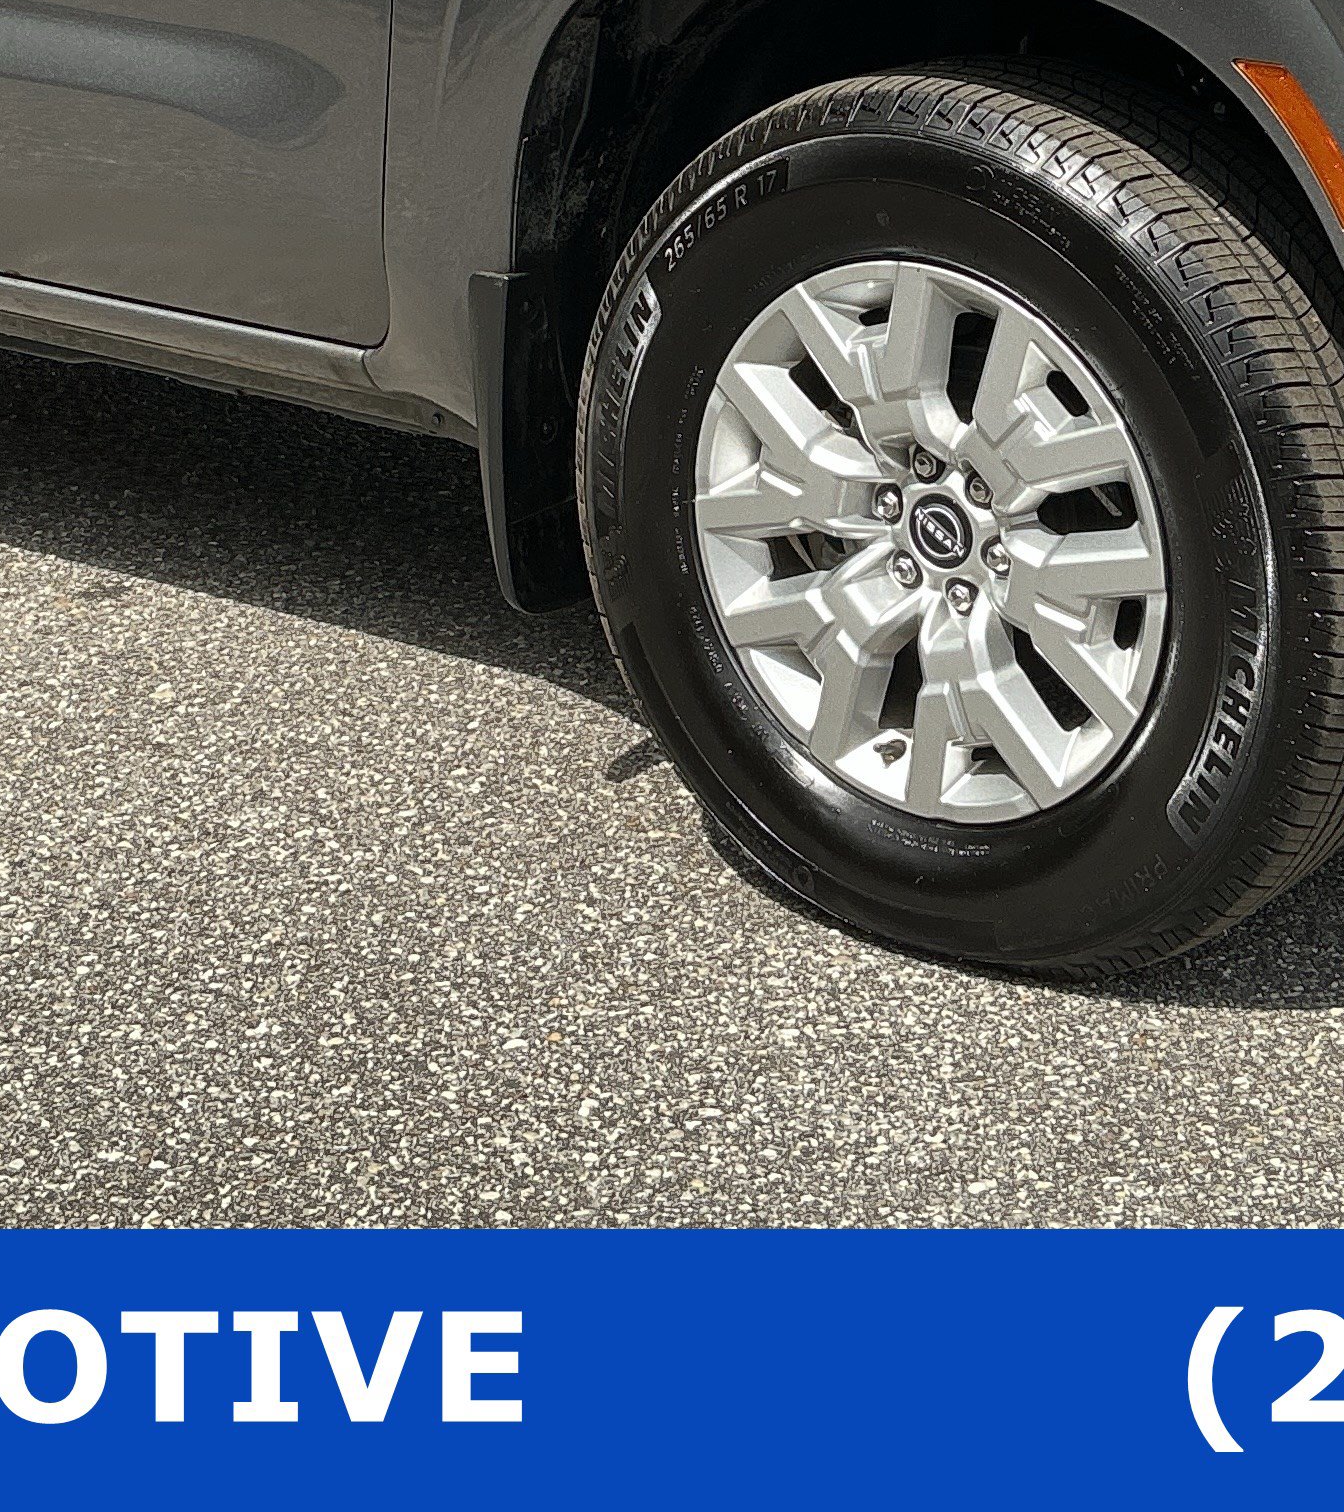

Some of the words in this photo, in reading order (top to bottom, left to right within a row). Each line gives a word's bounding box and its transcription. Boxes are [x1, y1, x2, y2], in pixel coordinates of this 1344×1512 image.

[664, 196, 728, 272] 265/65
[735, 186, 748, 207] R
[757, 169, 776, 195] 17
[915, 507, 965, 558] NISSAN
[1177, 576, 1258, 836] MICHELIN
